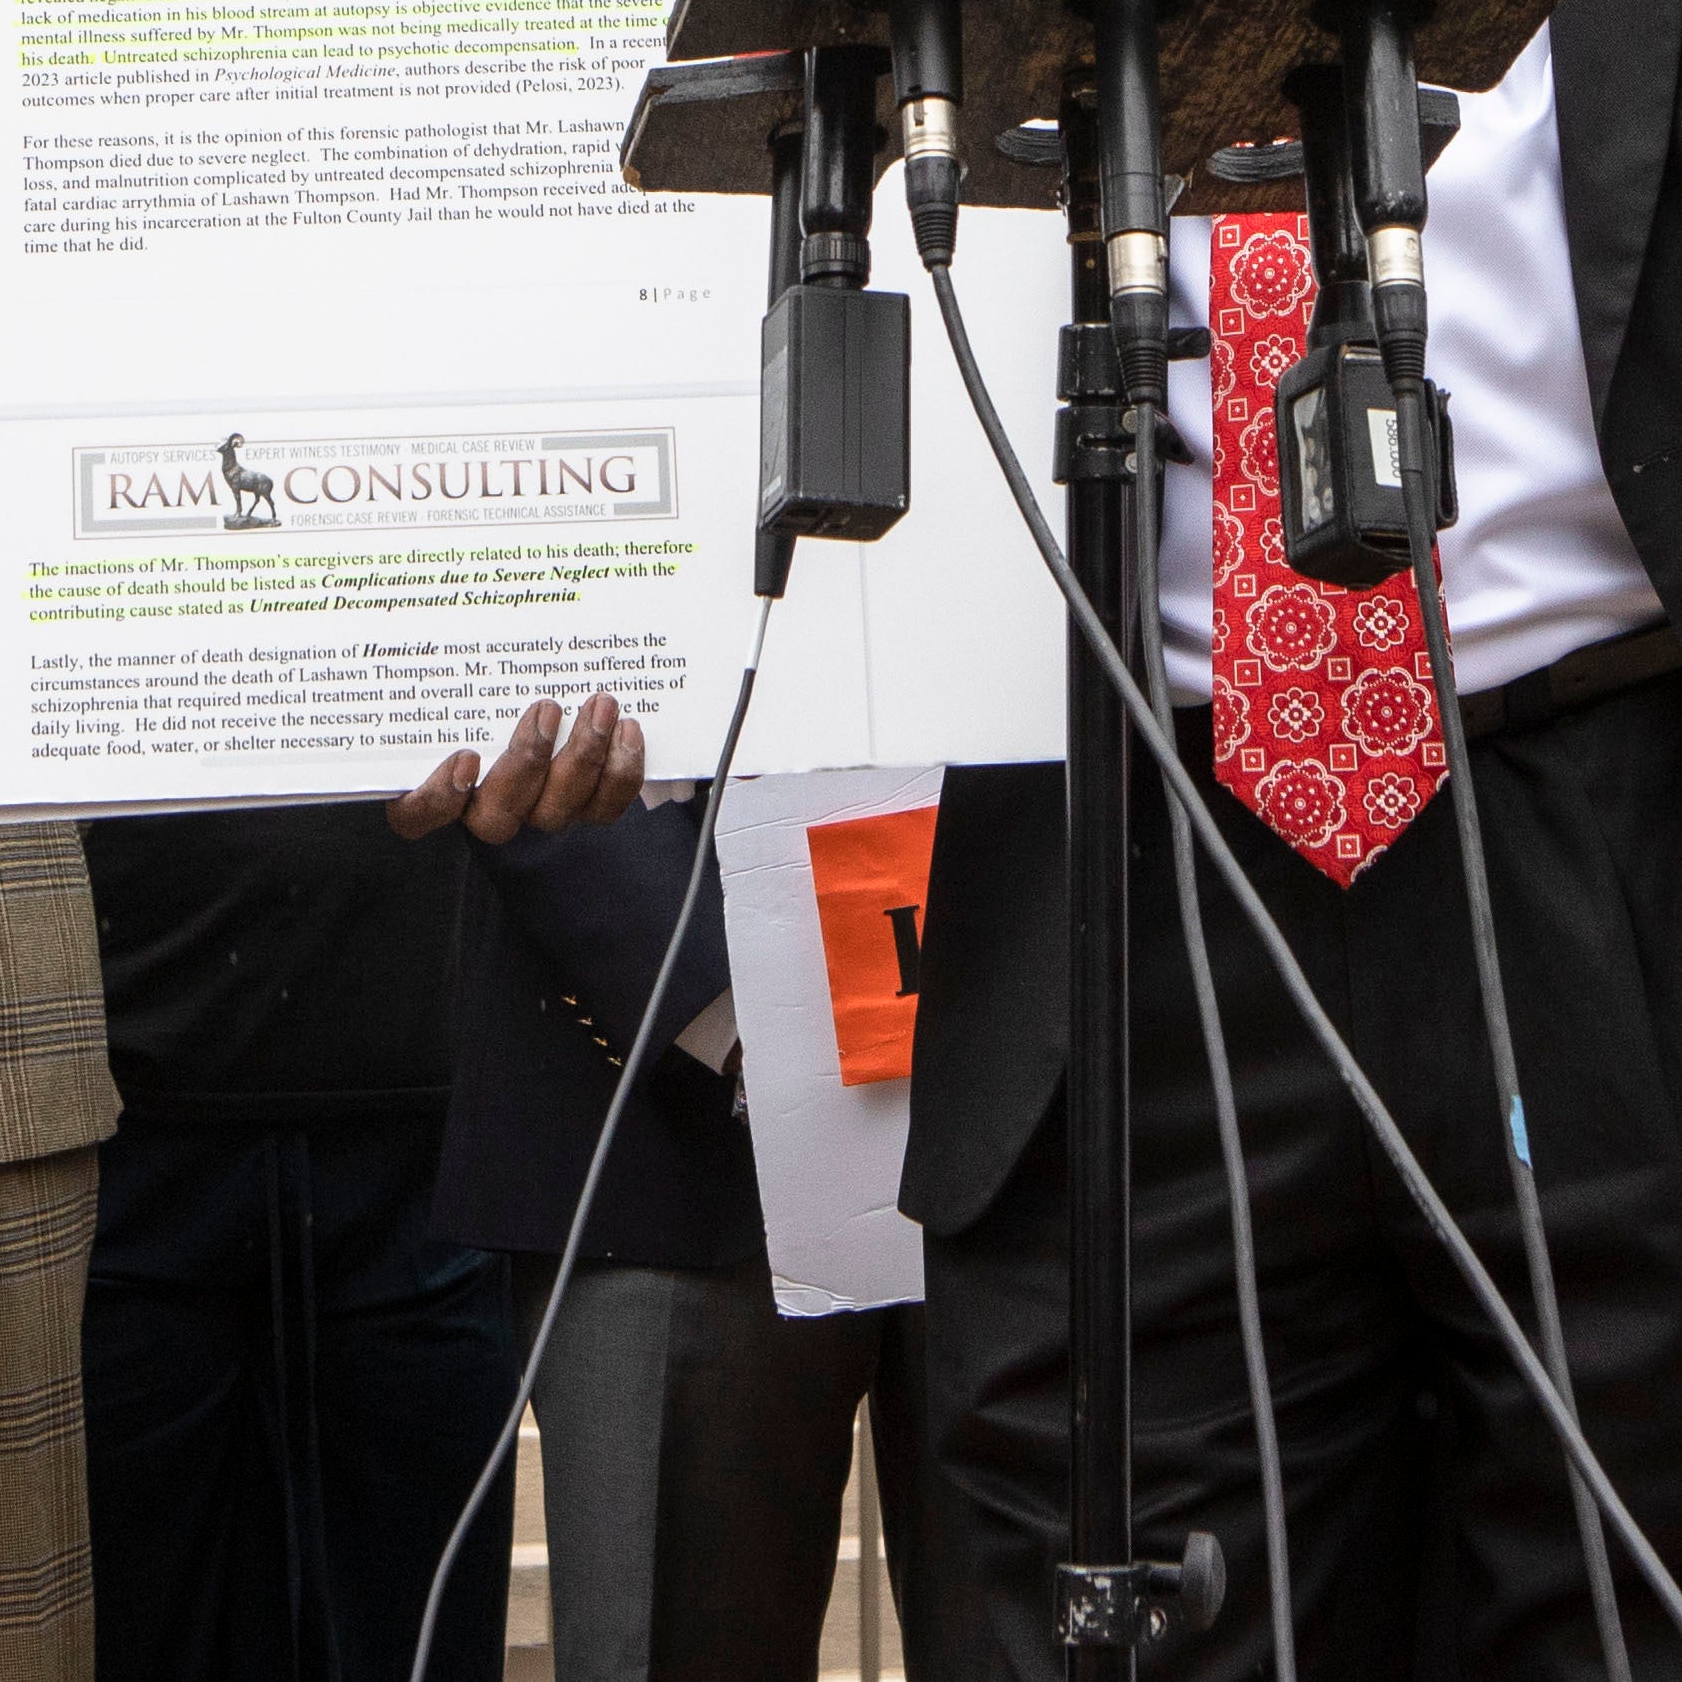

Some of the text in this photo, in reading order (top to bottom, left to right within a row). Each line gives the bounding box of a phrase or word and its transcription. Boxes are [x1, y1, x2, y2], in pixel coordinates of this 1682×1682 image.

[25, 236, 147, 254] time that he did.
[639, 288, 648, 301] 8
[110, 440, 535, 464] AUTOPSY SERVICES EXPERT WITNESS TESTIMONY MEDICAL CASE REVIEW
[109, 456, 637, 509] RAM CONSULTING
[290, 504, 606, 526] FORENSIC CASE REVIEW FORENSIC TECHNICAL ASSISTANCE
[29, 540, 692, 576] The inactions of Mr. Thompson's caregivers are directly related to his death; therefore
[30, 558, 675, 598] the cause of death should be listed as Complications due to Severe Neglect with the
[30, 588, 580, 622] contributing cause stated as Untreated Decompensated Schizophrenia.
